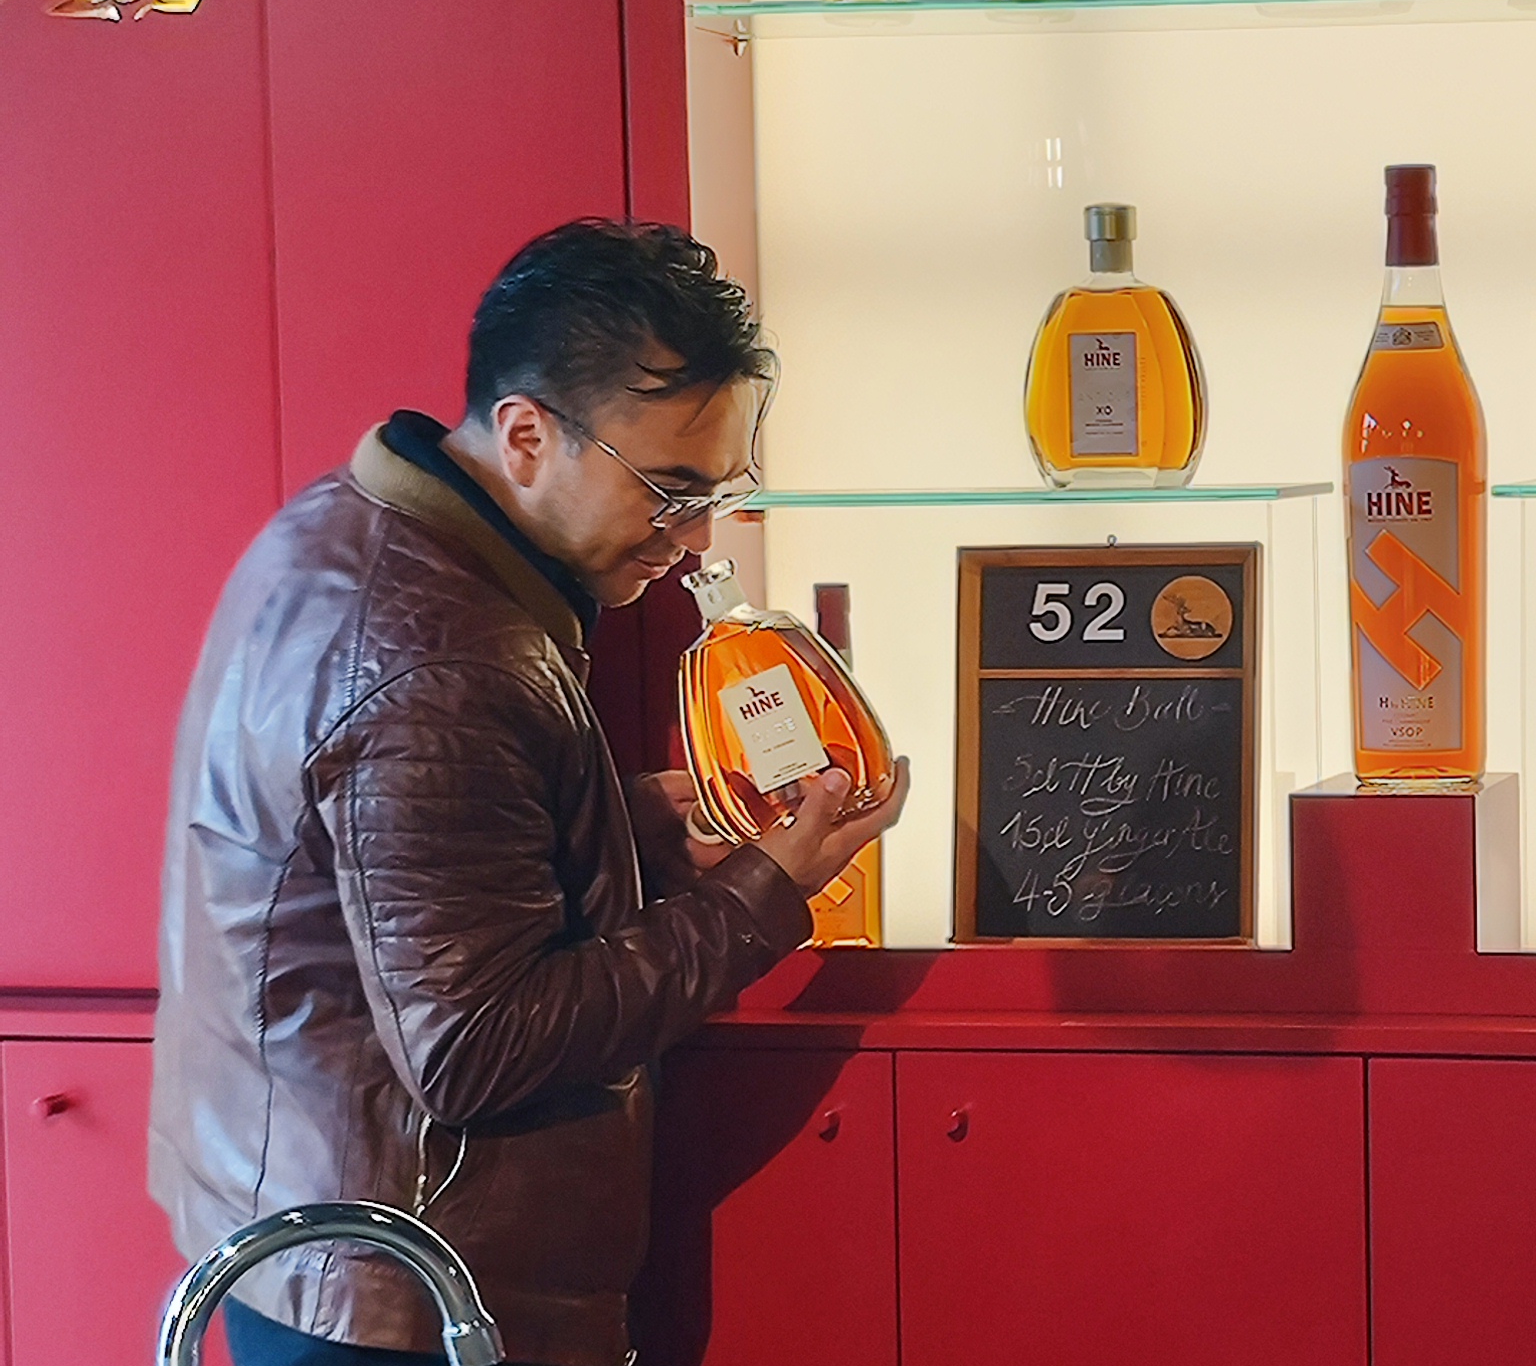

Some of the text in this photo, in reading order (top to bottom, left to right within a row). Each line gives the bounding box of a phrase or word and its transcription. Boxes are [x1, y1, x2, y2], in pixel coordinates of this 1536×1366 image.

[1084, 353, 1121, 367] HINE
[1096, 405, 1113, 416] XO
[1367, 491, 1432, 516] HINE
[1029, 582, 1125, 642] 52
[738, 691, 784, 720] HINE
[1391, 726, 1424, 737] VSOP
